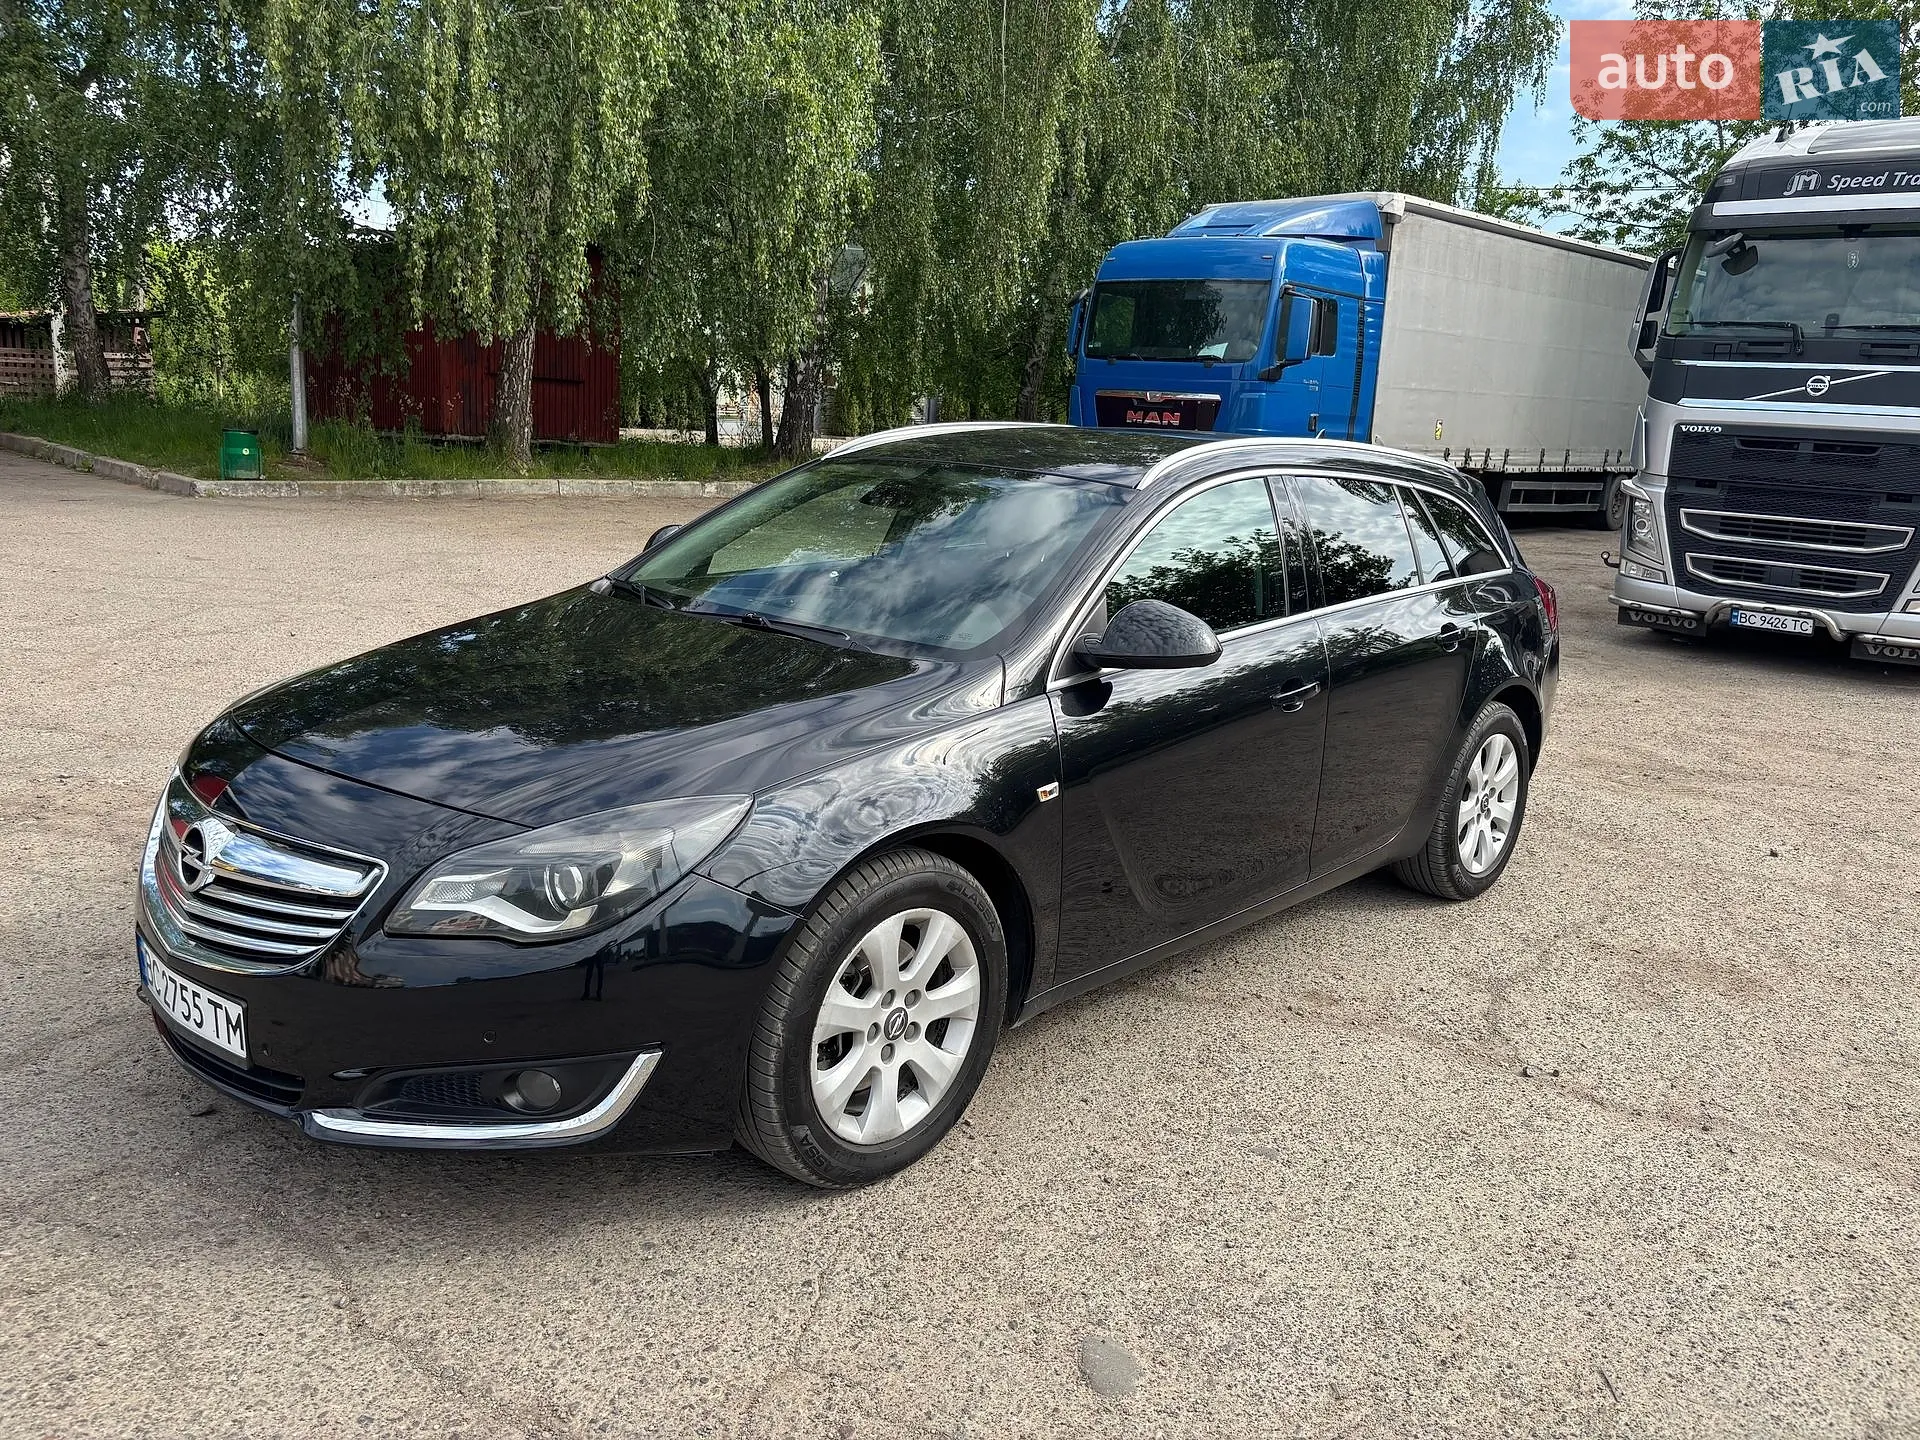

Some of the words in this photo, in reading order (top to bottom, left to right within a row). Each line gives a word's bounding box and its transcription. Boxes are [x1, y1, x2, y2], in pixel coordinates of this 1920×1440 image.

[1783, 173, 1818, 196] JM
[1827, 171, 1889, 192] Speed
[1126, 410, 1181, 426] MAN
[1680, 424, 1722, 433] VOLVO
[1628, 610, 1697, 629] VOLVO
[1739, 612, 1757, 625] BC
[1759, 615, 1788, 629] 9426
[1791, 619, 1809, 632] TC
[1864, 643, 1920, 659] VOL
[161, 969, 204, 1030] 2755
[207, 997, 245, 1052] TM
